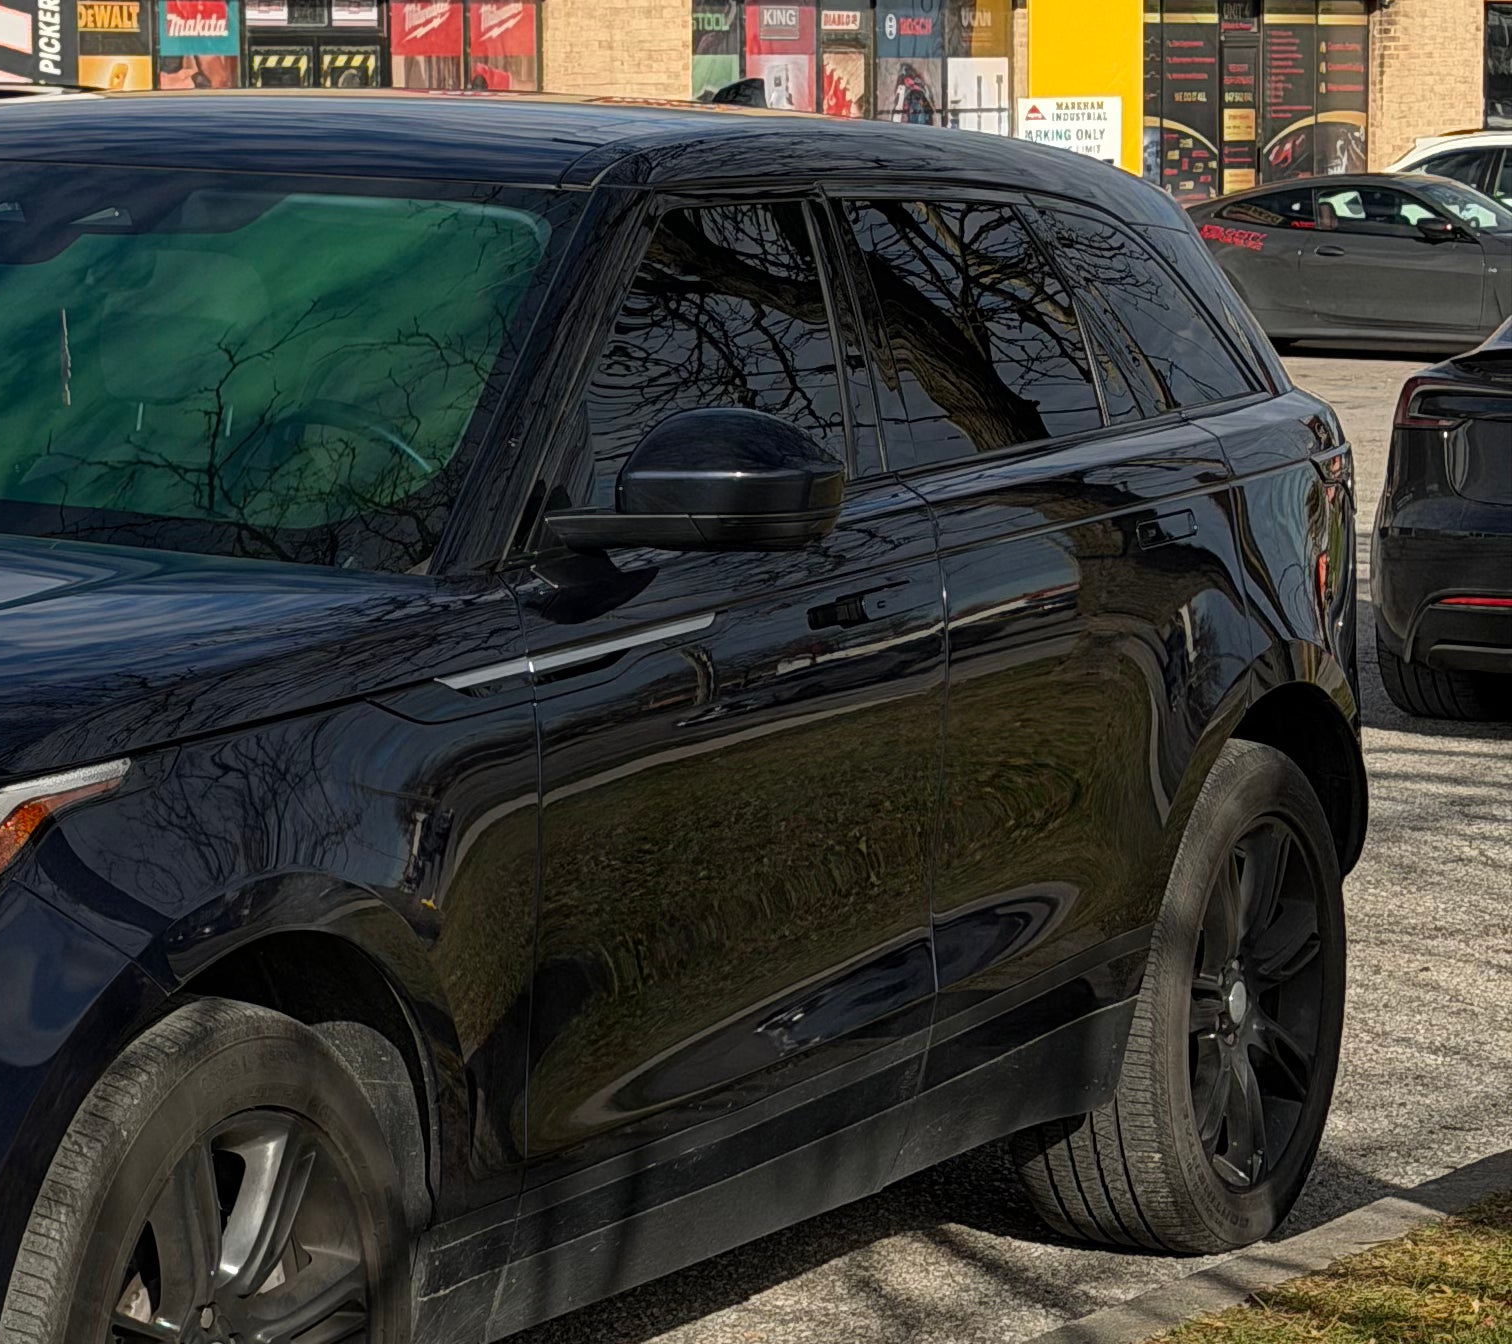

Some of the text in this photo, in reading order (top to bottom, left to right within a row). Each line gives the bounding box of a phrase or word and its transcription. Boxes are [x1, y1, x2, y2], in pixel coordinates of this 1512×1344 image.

[763, 9, 796, 25] KING
[1056, 101, 1104, 110] MARKHAM
[1052, 112, 1107, 122] INDUSTRIAL
[1076, 128, 1105, 140] ONLY
